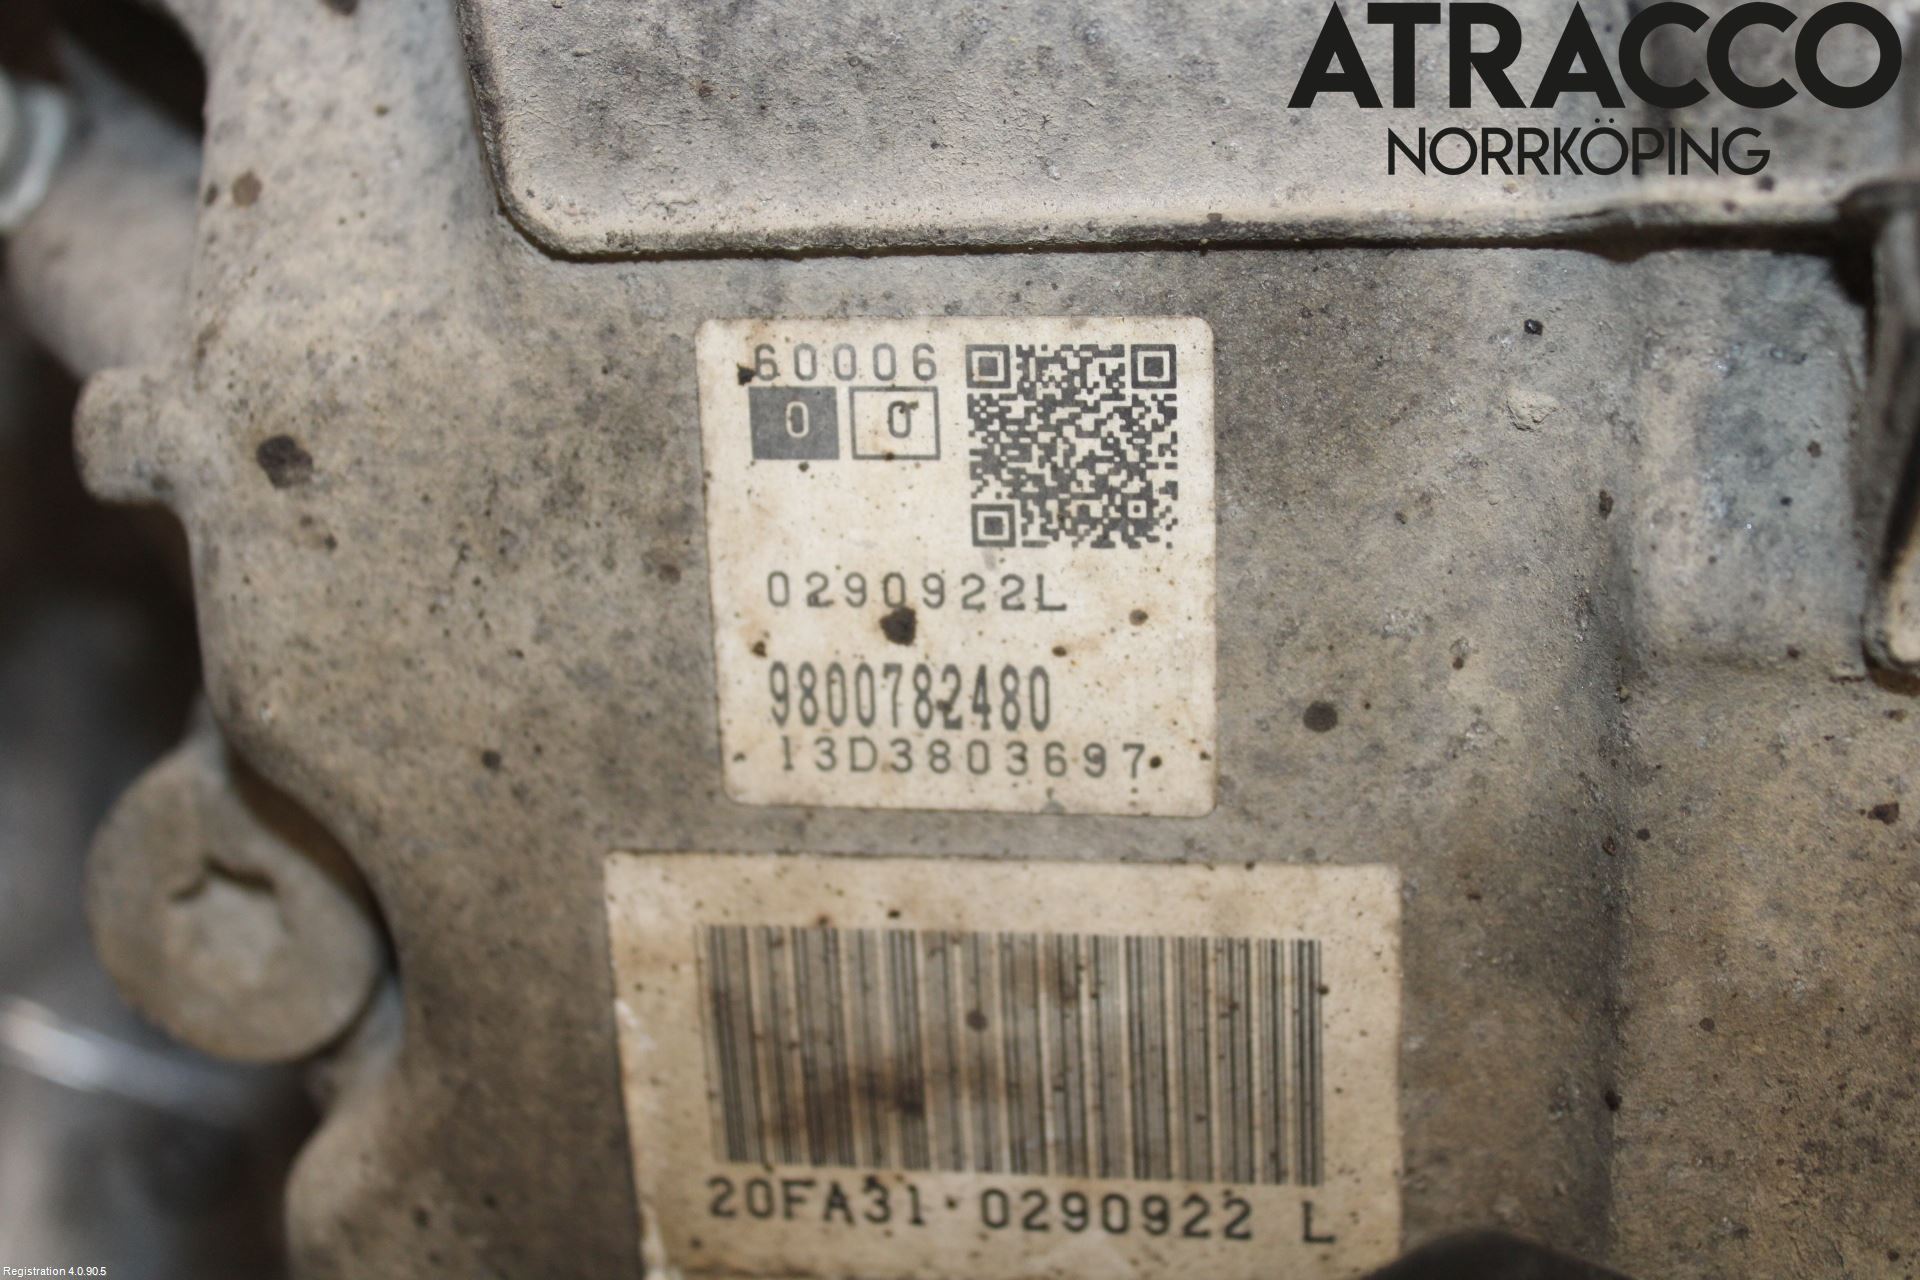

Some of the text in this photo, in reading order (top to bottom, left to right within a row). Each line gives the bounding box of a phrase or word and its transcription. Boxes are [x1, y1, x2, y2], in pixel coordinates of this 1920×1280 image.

[753, 343, 937, 381] 60006
[767, 571, 1067, 612] 0290922L
[769, 661, 1051, 732] 9800782480
[782, 736, 1146, 780] 13D3803697
[980, 1188, 1254, 1242] 0290922
[1303, 1202, 1335, 1244] L
